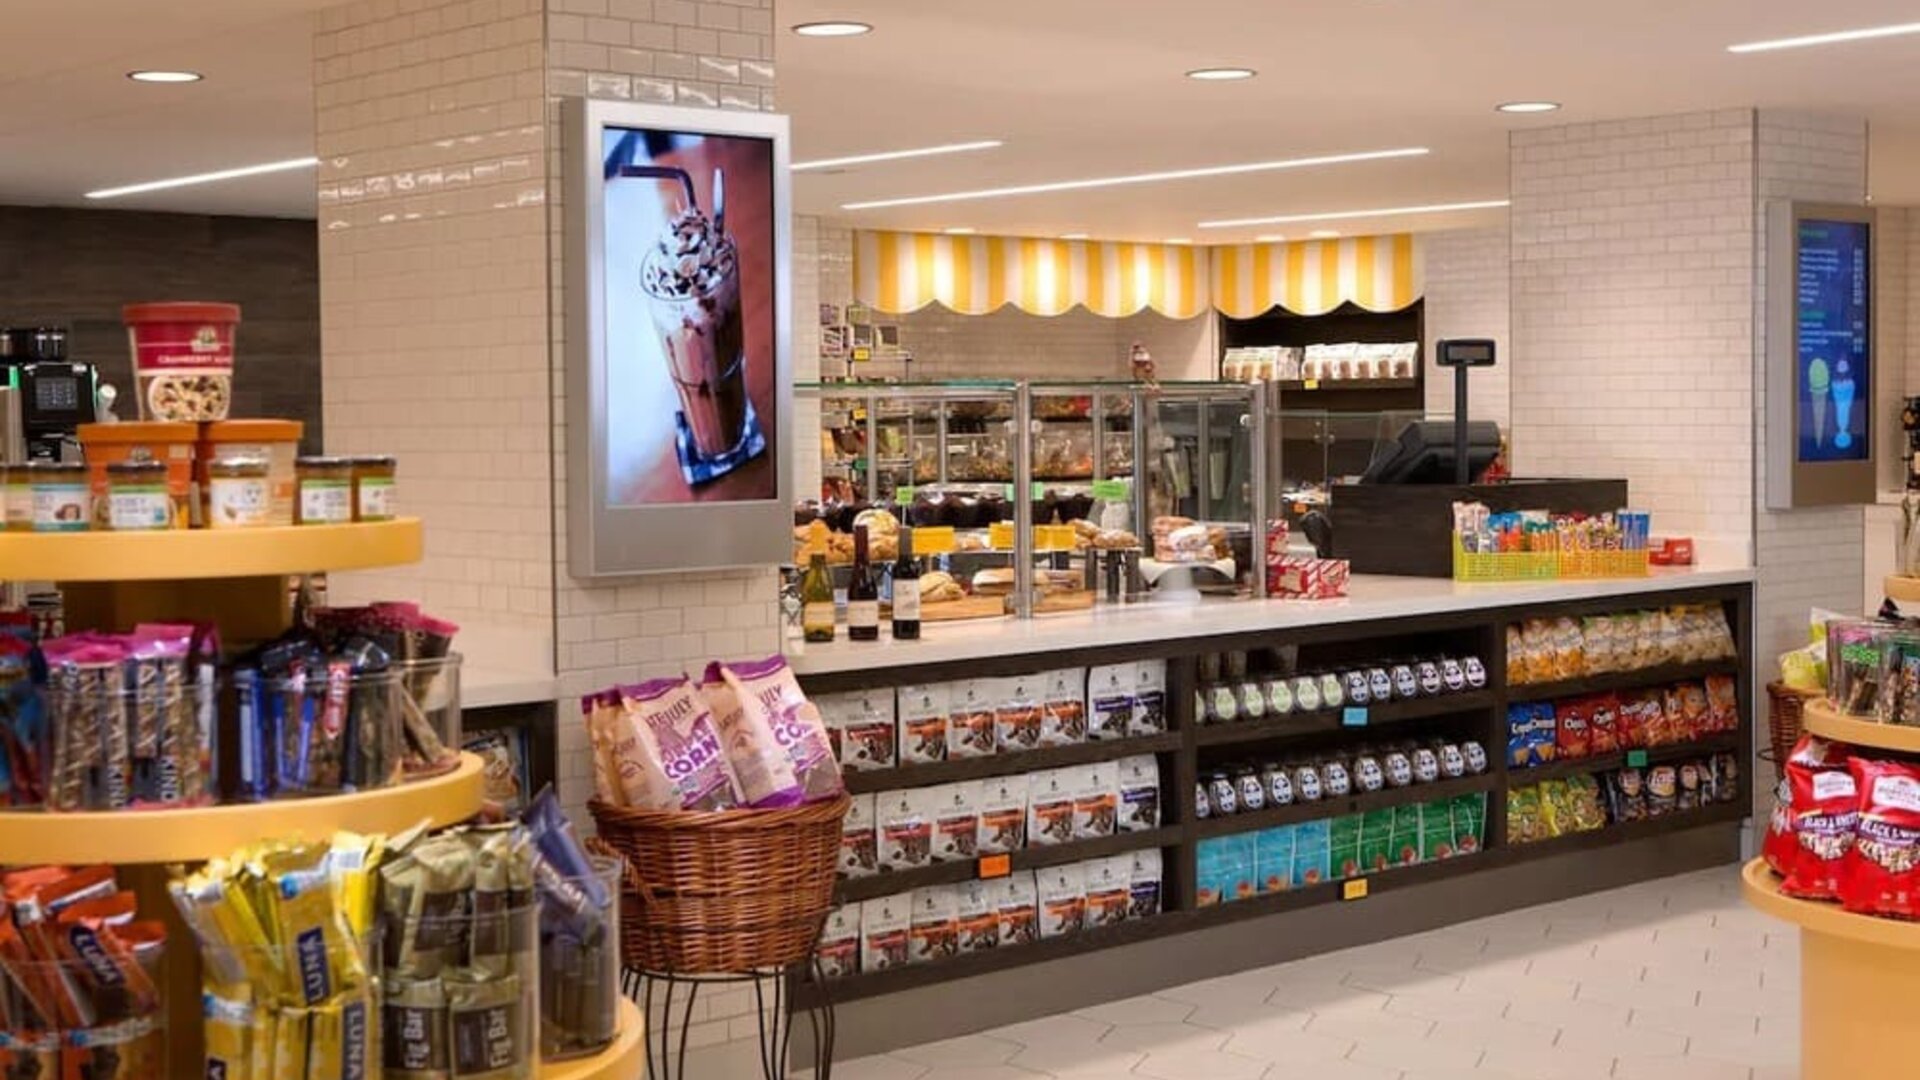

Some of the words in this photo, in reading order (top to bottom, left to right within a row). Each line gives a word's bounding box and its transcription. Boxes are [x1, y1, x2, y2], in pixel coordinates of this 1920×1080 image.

[664, 734, 720, 779] CORN
[160, 755, 178, 801] KIND
[1859, 819, 1890, 838] BLACK
[74, 930, 118, 983] LUNA
[303, 934, 326, 1005] LUNA
[403, 1009, 424, 1040] Bar
[488, 1009, 508, 1039] Bar
[348, 1008, 366, 1080] LUNA
[404, 1041, 430, 1069] Fig
[489, 1039, 512, 1068] Fig
